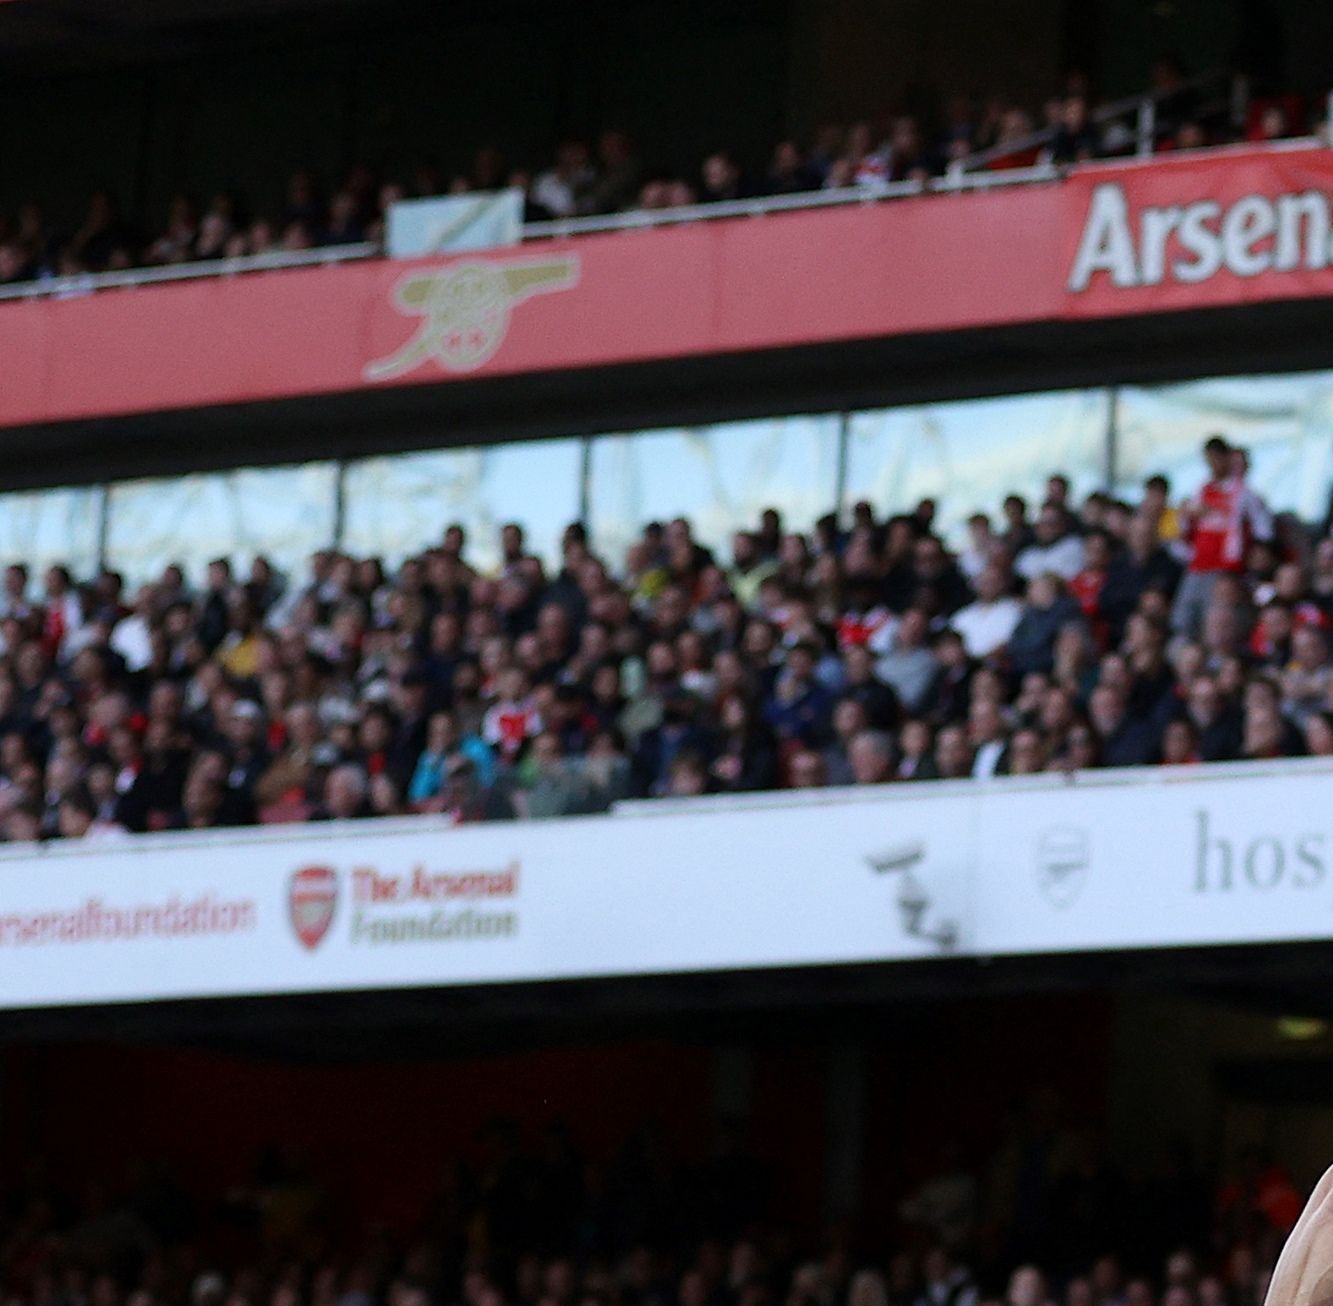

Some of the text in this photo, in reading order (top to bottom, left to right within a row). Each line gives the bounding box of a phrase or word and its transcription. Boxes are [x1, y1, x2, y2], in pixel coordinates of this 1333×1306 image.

[352, 858, 522, 901] The Arsenal
[350, 908, 519, 943] Foundation
